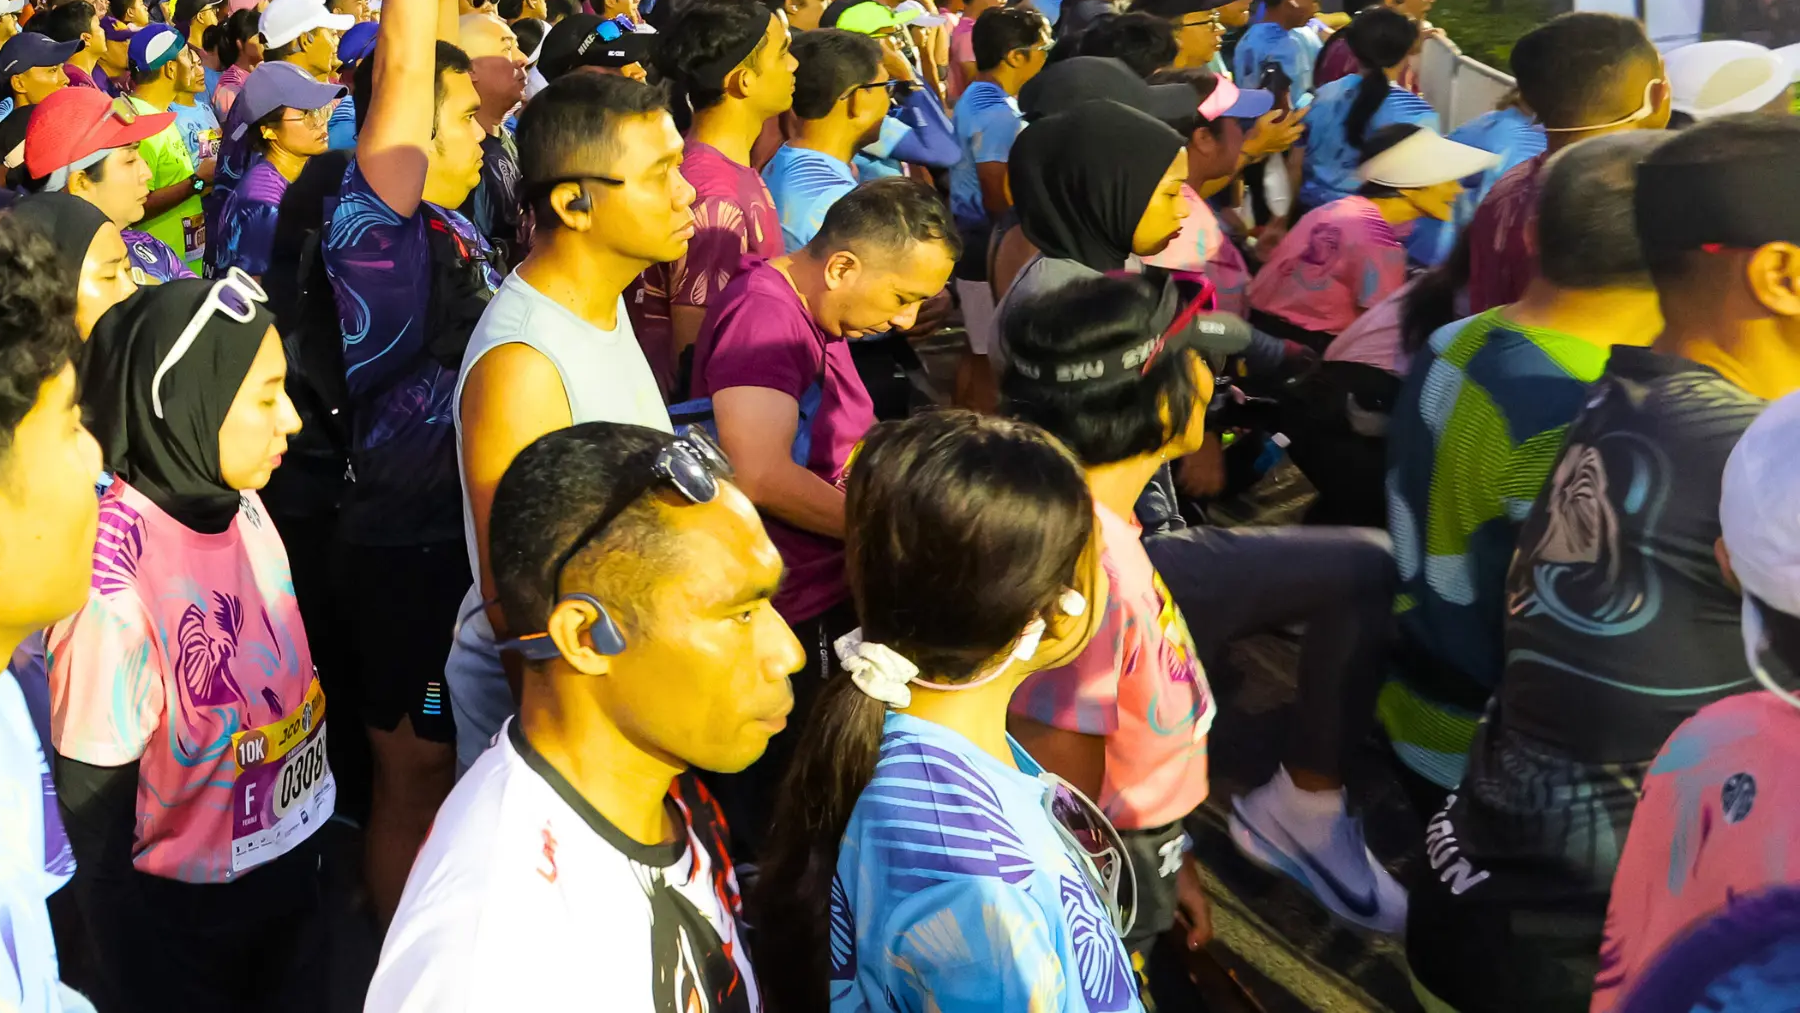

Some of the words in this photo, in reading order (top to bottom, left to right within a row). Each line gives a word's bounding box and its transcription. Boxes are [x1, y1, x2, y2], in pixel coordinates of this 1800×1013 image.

[577, 33, 596, 56] NIKE
[278, 717, 301, 746] JCO
[238, 736, 265, 766] 10K
[280, 736, 324, 810] 0308
[244, 782, 257, 817] F
